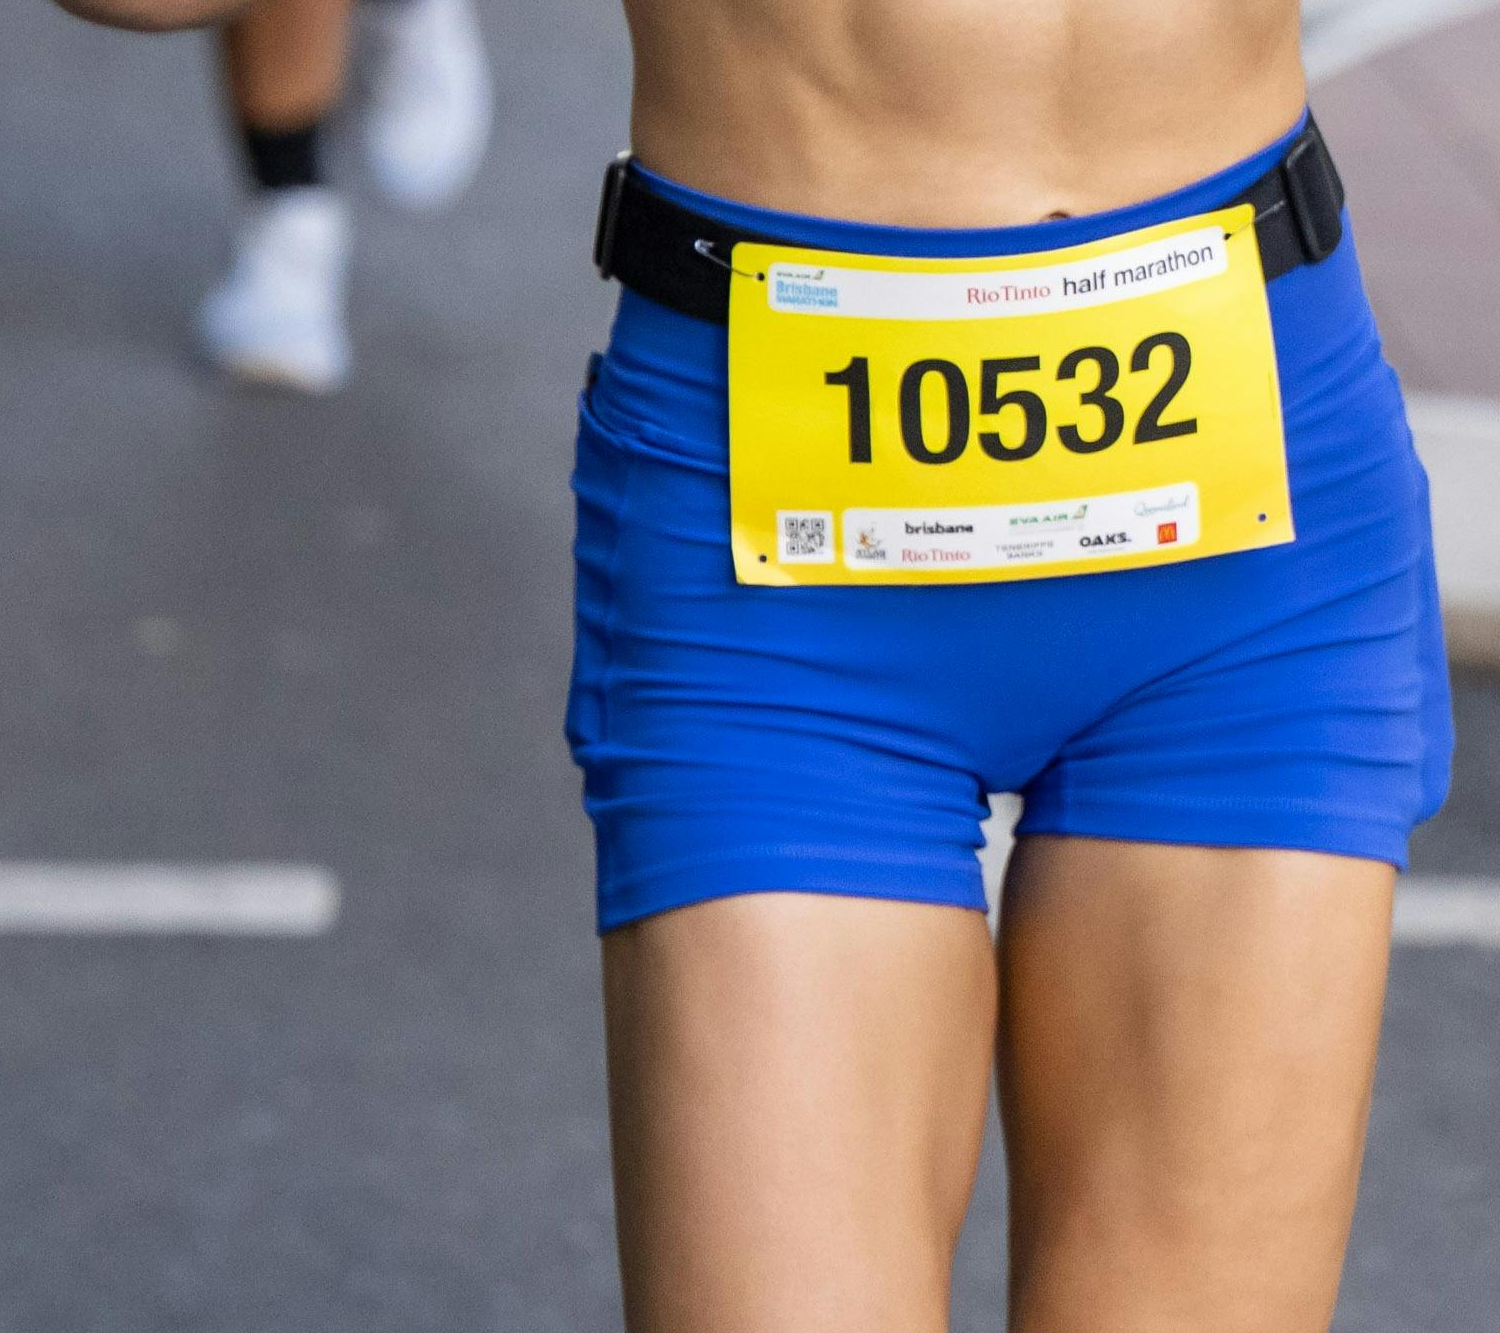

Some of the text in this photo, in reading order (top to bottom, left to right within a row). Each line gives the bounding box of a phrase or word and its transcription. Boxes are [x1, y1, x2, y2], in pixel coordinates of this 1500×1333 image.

[1063, 270, 1106, 296] half
[1114, 245, 1213, 286] marathon
[776, 280, 838, 297] Brisbane
[824, 331, 1198, 465] 10532
[904, 521, 973, 534] brisbane
